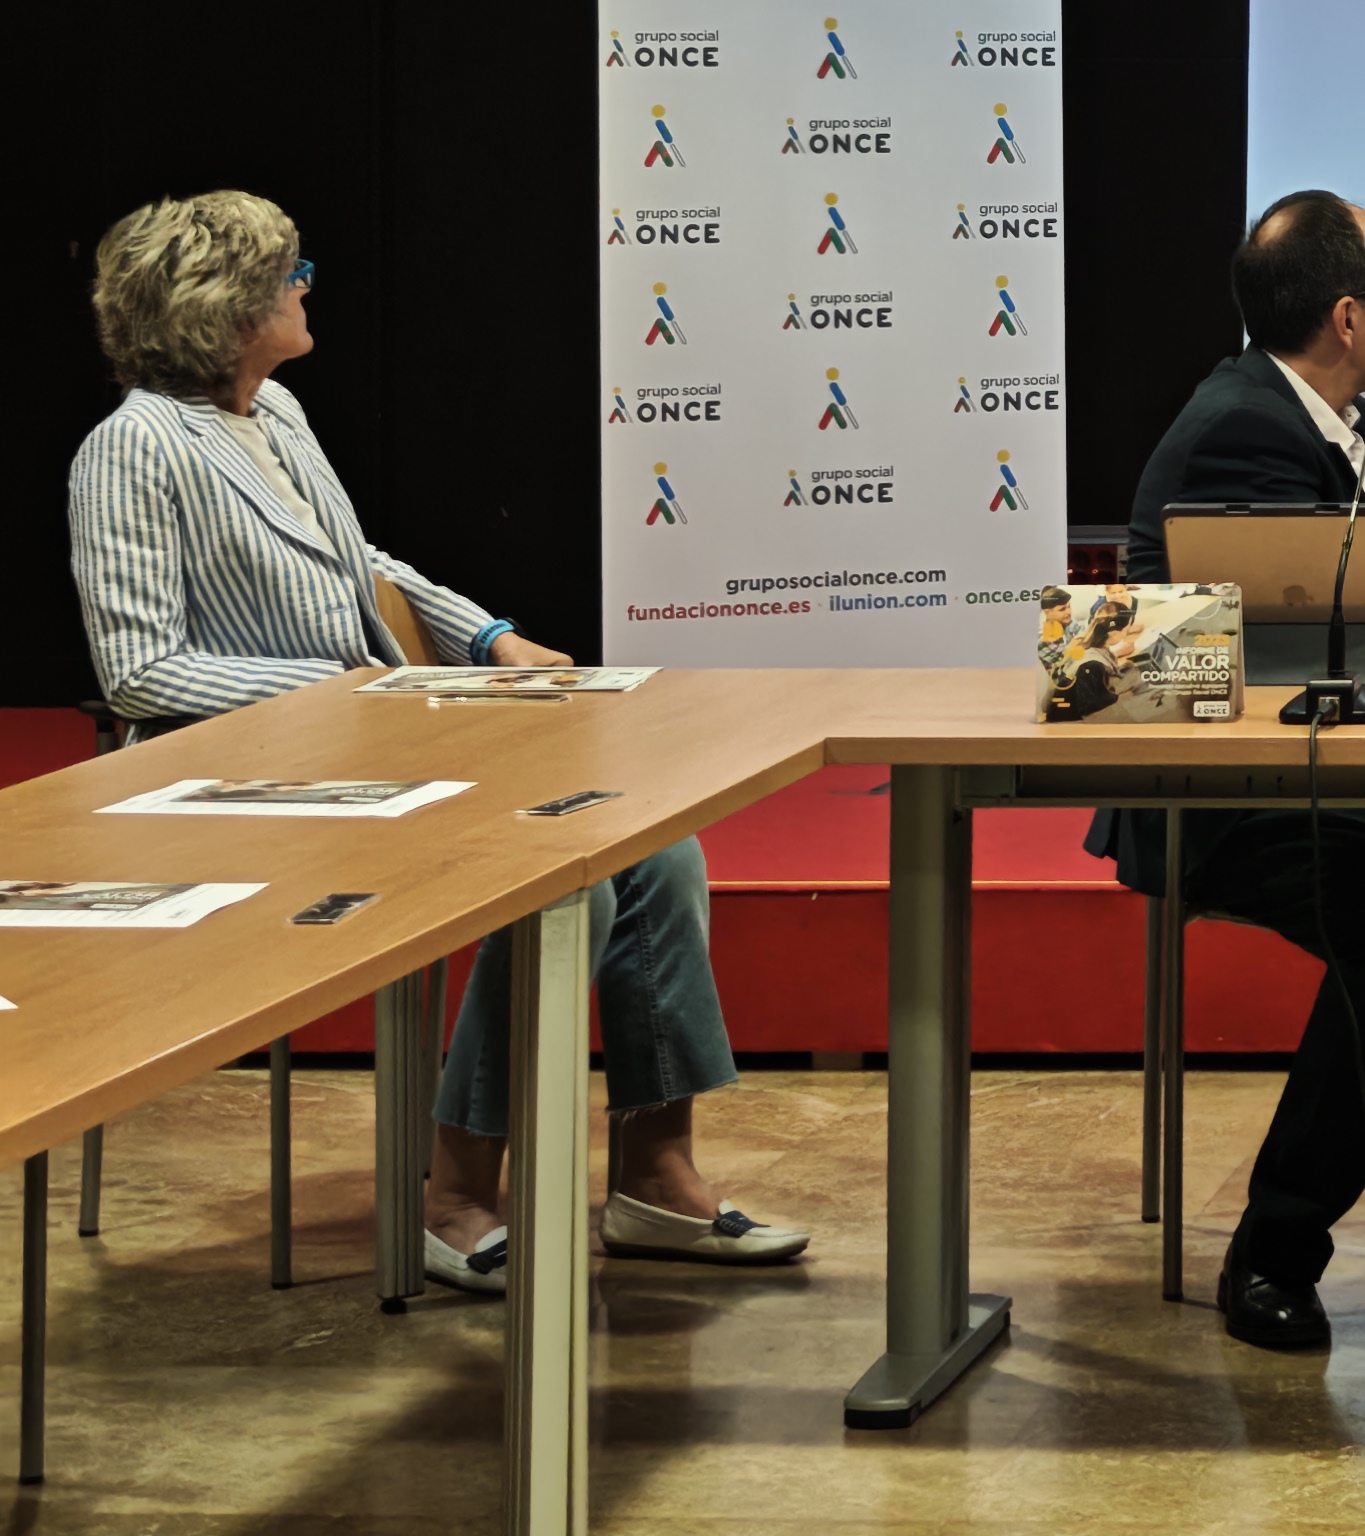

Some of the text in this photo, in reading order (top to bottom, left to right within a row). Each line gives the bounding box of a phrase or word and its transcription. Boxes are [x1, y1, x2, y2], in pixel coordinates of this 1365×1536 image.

[635, 29, 718, 44] grupo social
[978, 30, 1055, 44] grupo social
[635, 47, 718, 67] ONCE
[978, 47, 1055, 66] ONCE
[809, 116, 891, 131] grupo social
[809, 134, 891, 154] ONCE
[636, 206, 720, 221] grupo social
[980, 201, 1057, 216] grupo social
[636, 224, 720, 244] ONCE
[980, 219, 1057, 239] ONCE
[811, 290, 892, 307] grupo social
[810, 308, 892, 329] ONCE
[981, 373, 1059, 390] grupo social
[637, 382, 721, 400] grupo social
[981, 391, 1059, 412] ONCE
[637, 401, 720, 423] ONCE
[812, 465, 893, 483] grupo social
[811, 483, 893, 505] ONCE
[726, 570, 946, 595] gruposocialonce.com
[628, 590, 1040, 621] fundaciononce.es ilunion.com once.es
[1165, 654, 1230, 670] VALOR
[1141, 670, 1230, 682] COMPARTIDO
